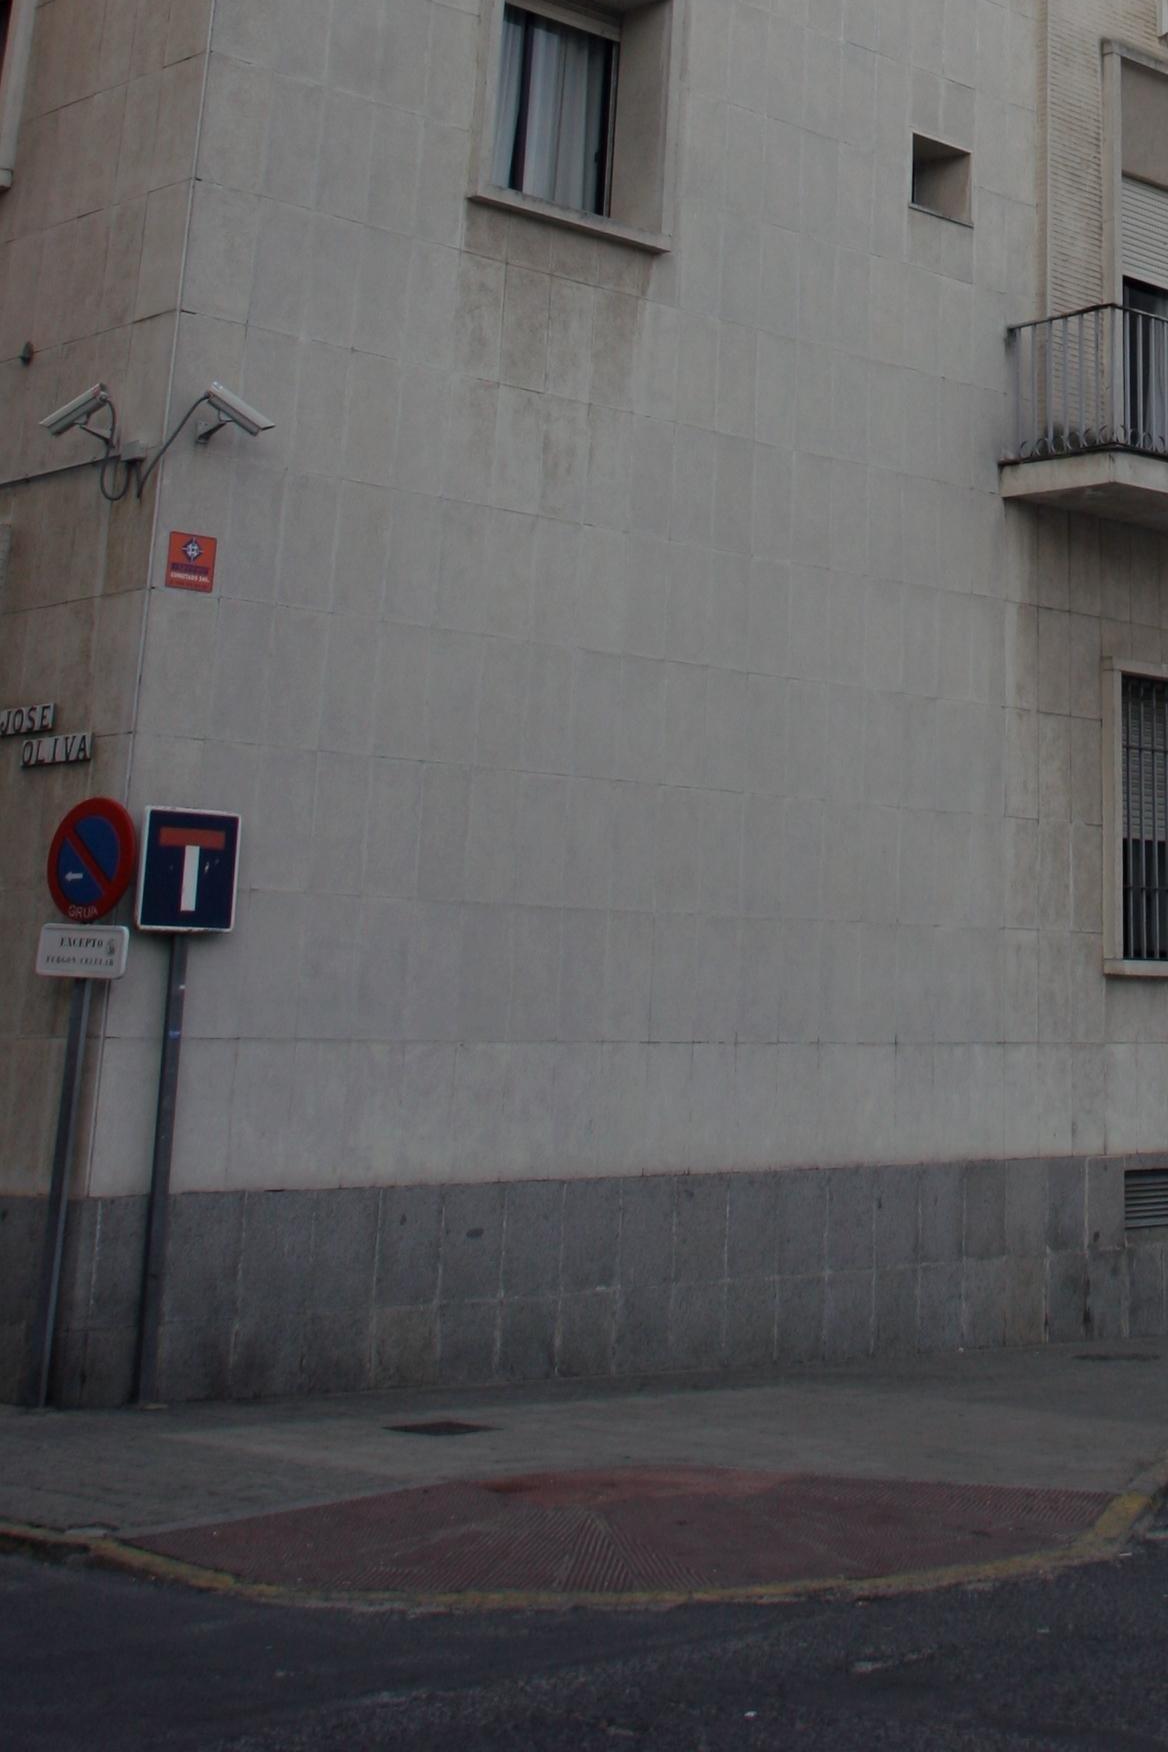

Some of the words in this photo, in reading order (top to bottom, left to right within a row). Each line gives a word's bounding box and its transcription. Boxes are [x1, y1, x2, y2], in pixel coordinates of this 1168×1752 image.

[0, 705, 52, 734] JOSE
[22, 735, 91, 765] OLIVA
[68, 904, 98, 919] GRUA
[60, 937, 104, 948] EXCEPTO
